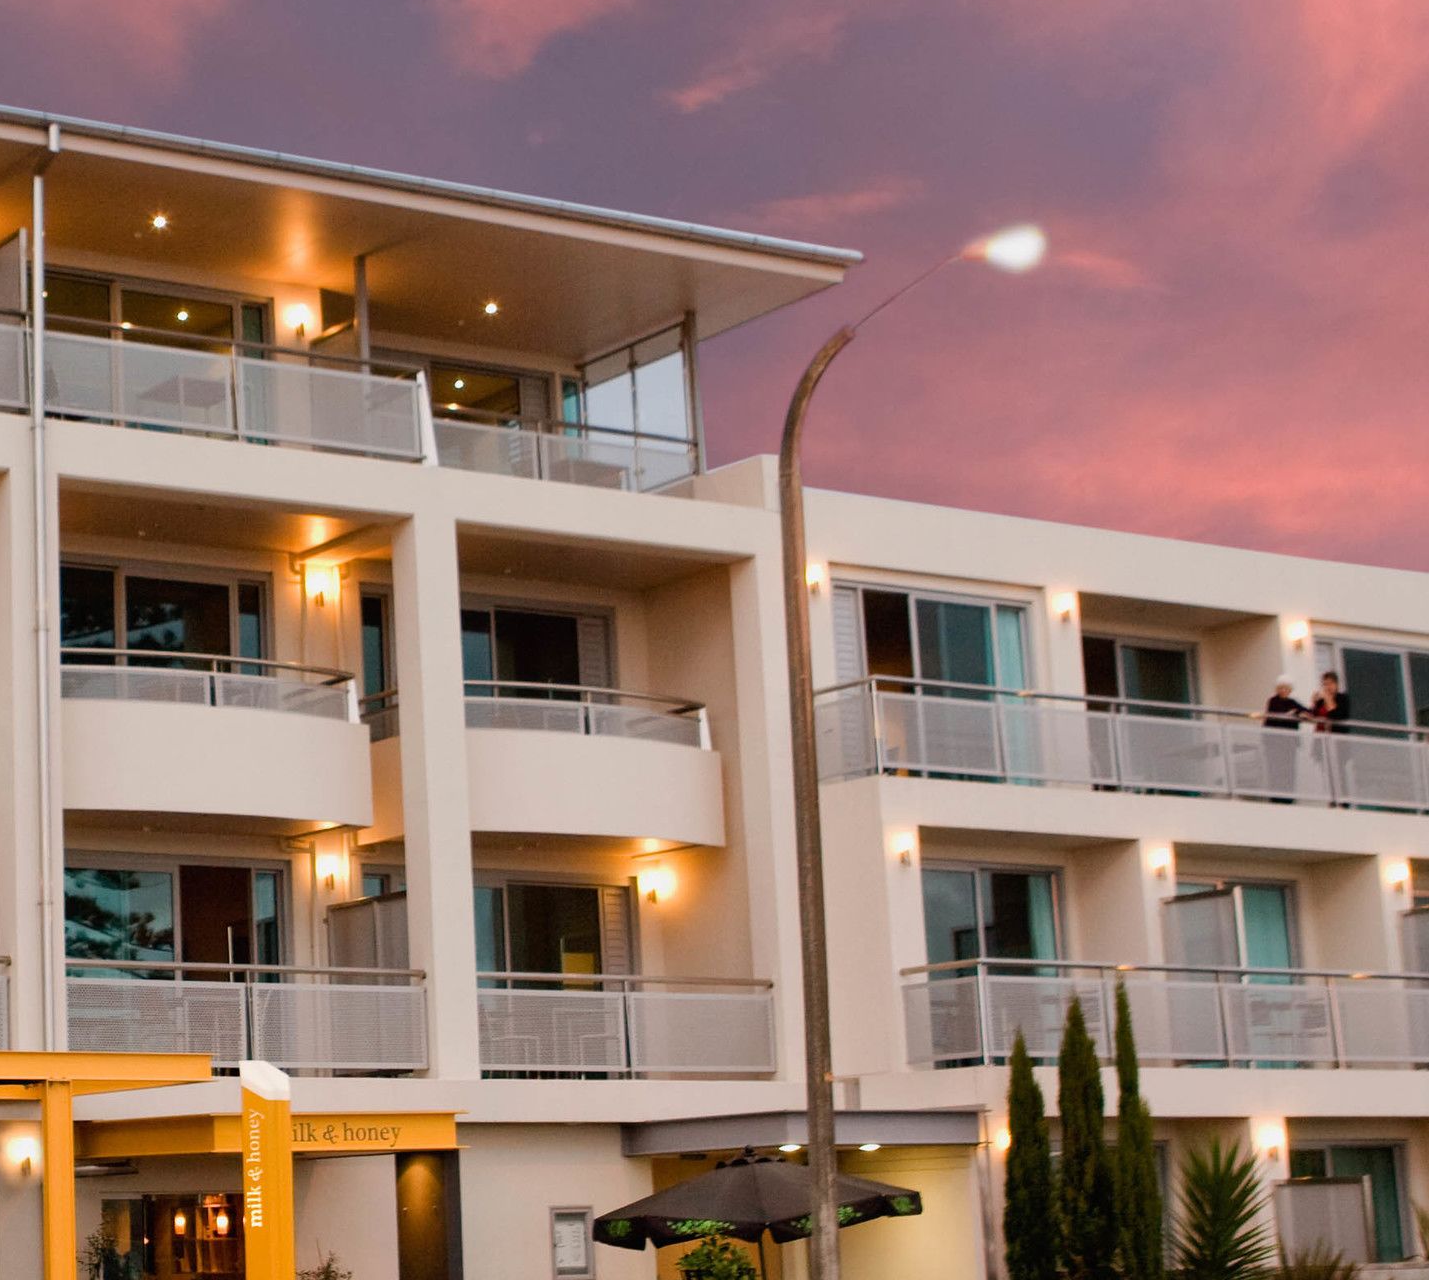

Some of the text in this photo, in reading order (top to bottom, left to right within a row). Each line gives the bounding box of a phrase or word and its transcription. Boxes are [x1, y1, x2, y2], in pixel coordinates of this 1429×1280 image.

[246, 1108, 265, 1228] milk & honey
[291, 1122, 402, 1148] ilk & honey
